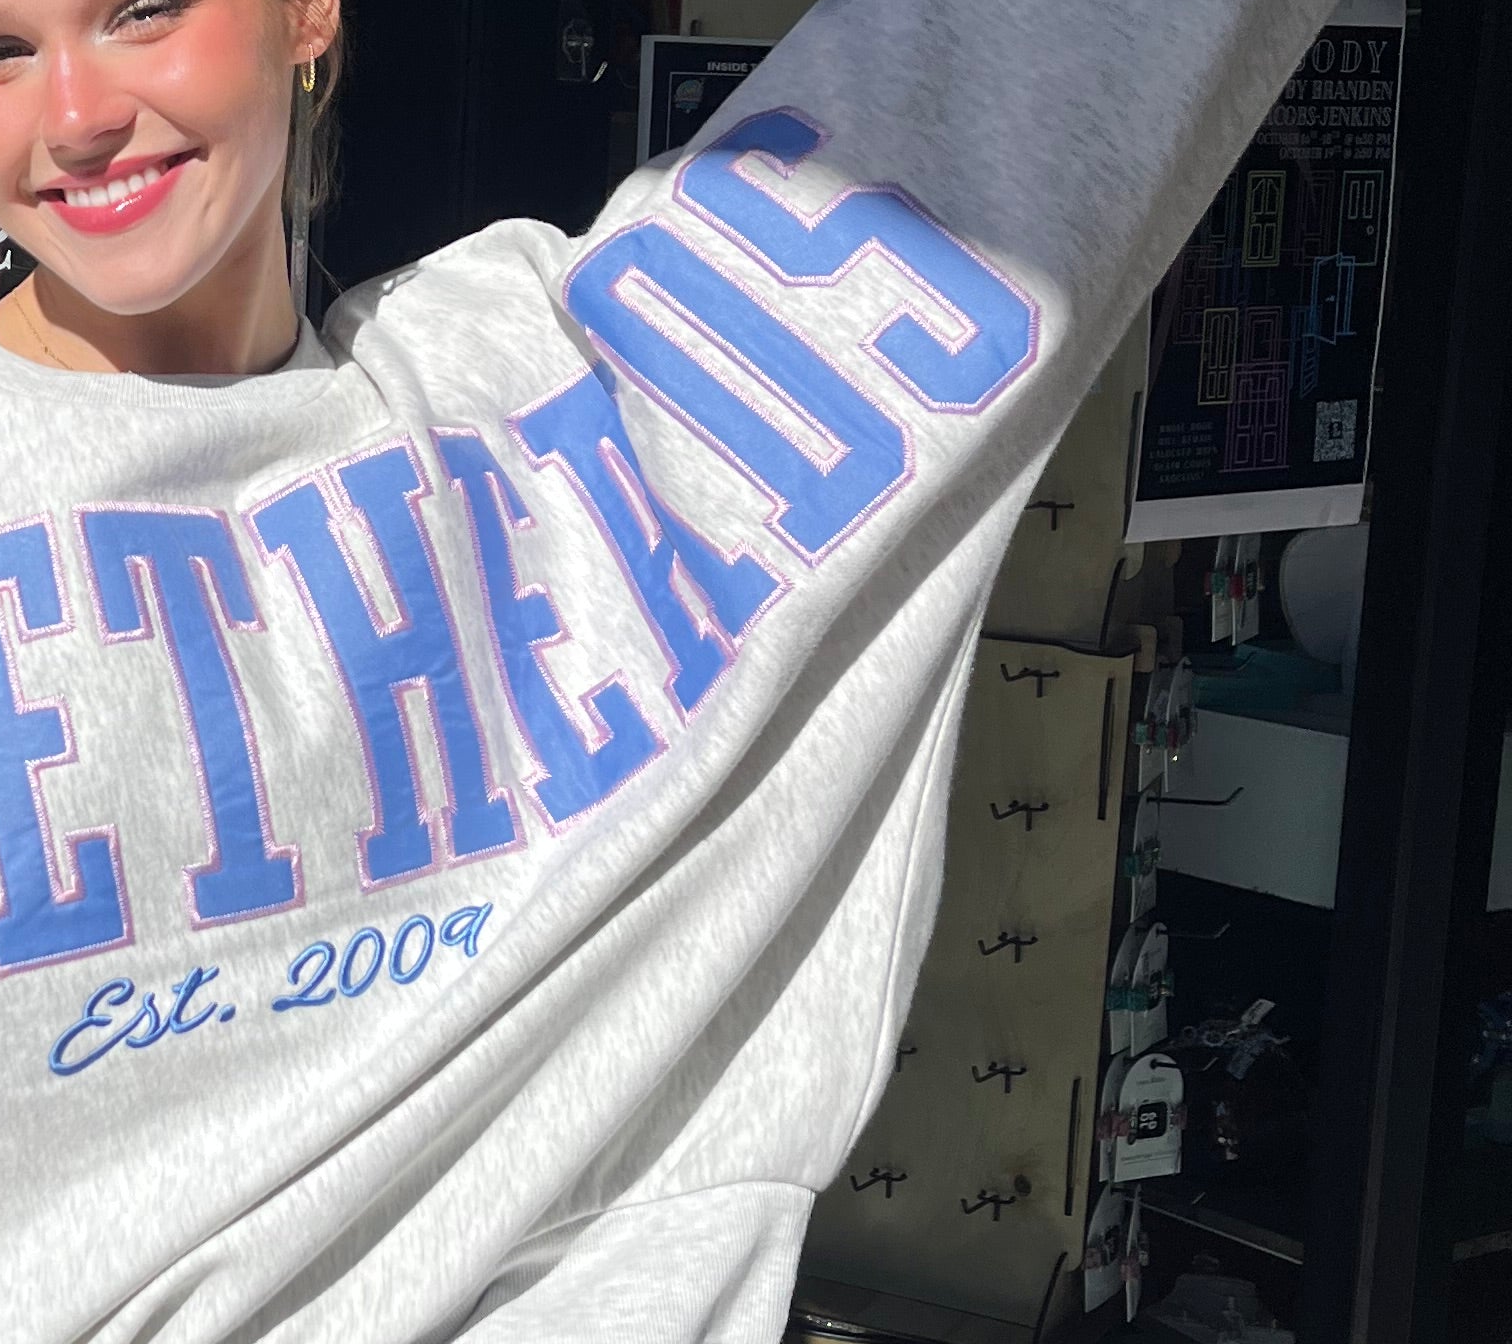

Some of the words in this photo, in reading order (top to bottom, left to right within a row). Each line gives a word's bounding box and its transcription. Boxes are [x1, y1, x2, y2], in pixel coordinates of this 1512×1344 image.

[706, 61, 748, 72] INSIDE
[1296, 38, 1388, 74] ODY
[47, 966, 236, 1076] Est.
[271, 902, 494, 1013] 2009
